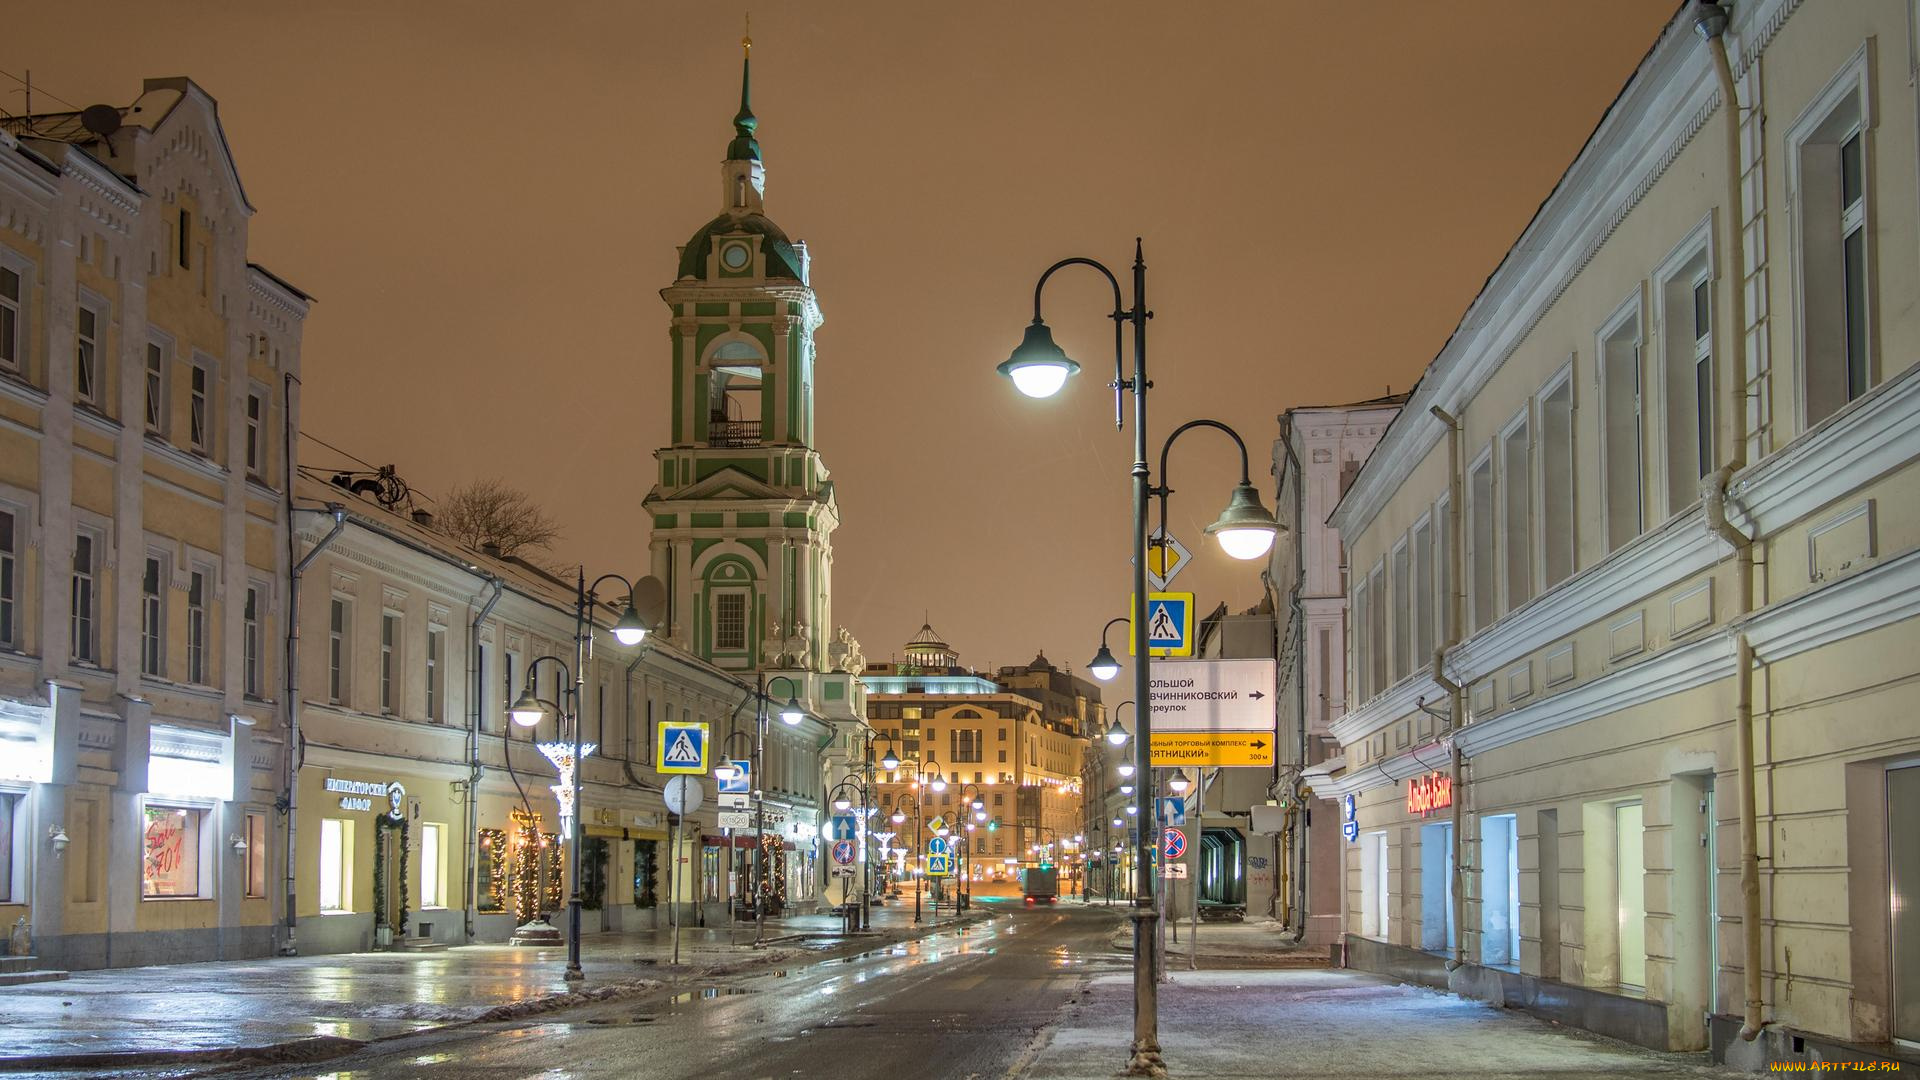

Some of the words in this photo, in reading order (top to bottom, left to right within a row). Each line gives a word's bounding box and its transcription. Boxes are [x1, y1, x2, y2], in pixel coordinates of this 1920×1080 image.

[1149, 678, 1194, 688] ОЛЬШОЙ
[1150, 690, 1238, 701] ВЧИННИКОВСКИЙ
[1150, 704, 1187, 713] ереулок
[1150, 748, 1209, 759] ПЯТНИЦКИЙ»
